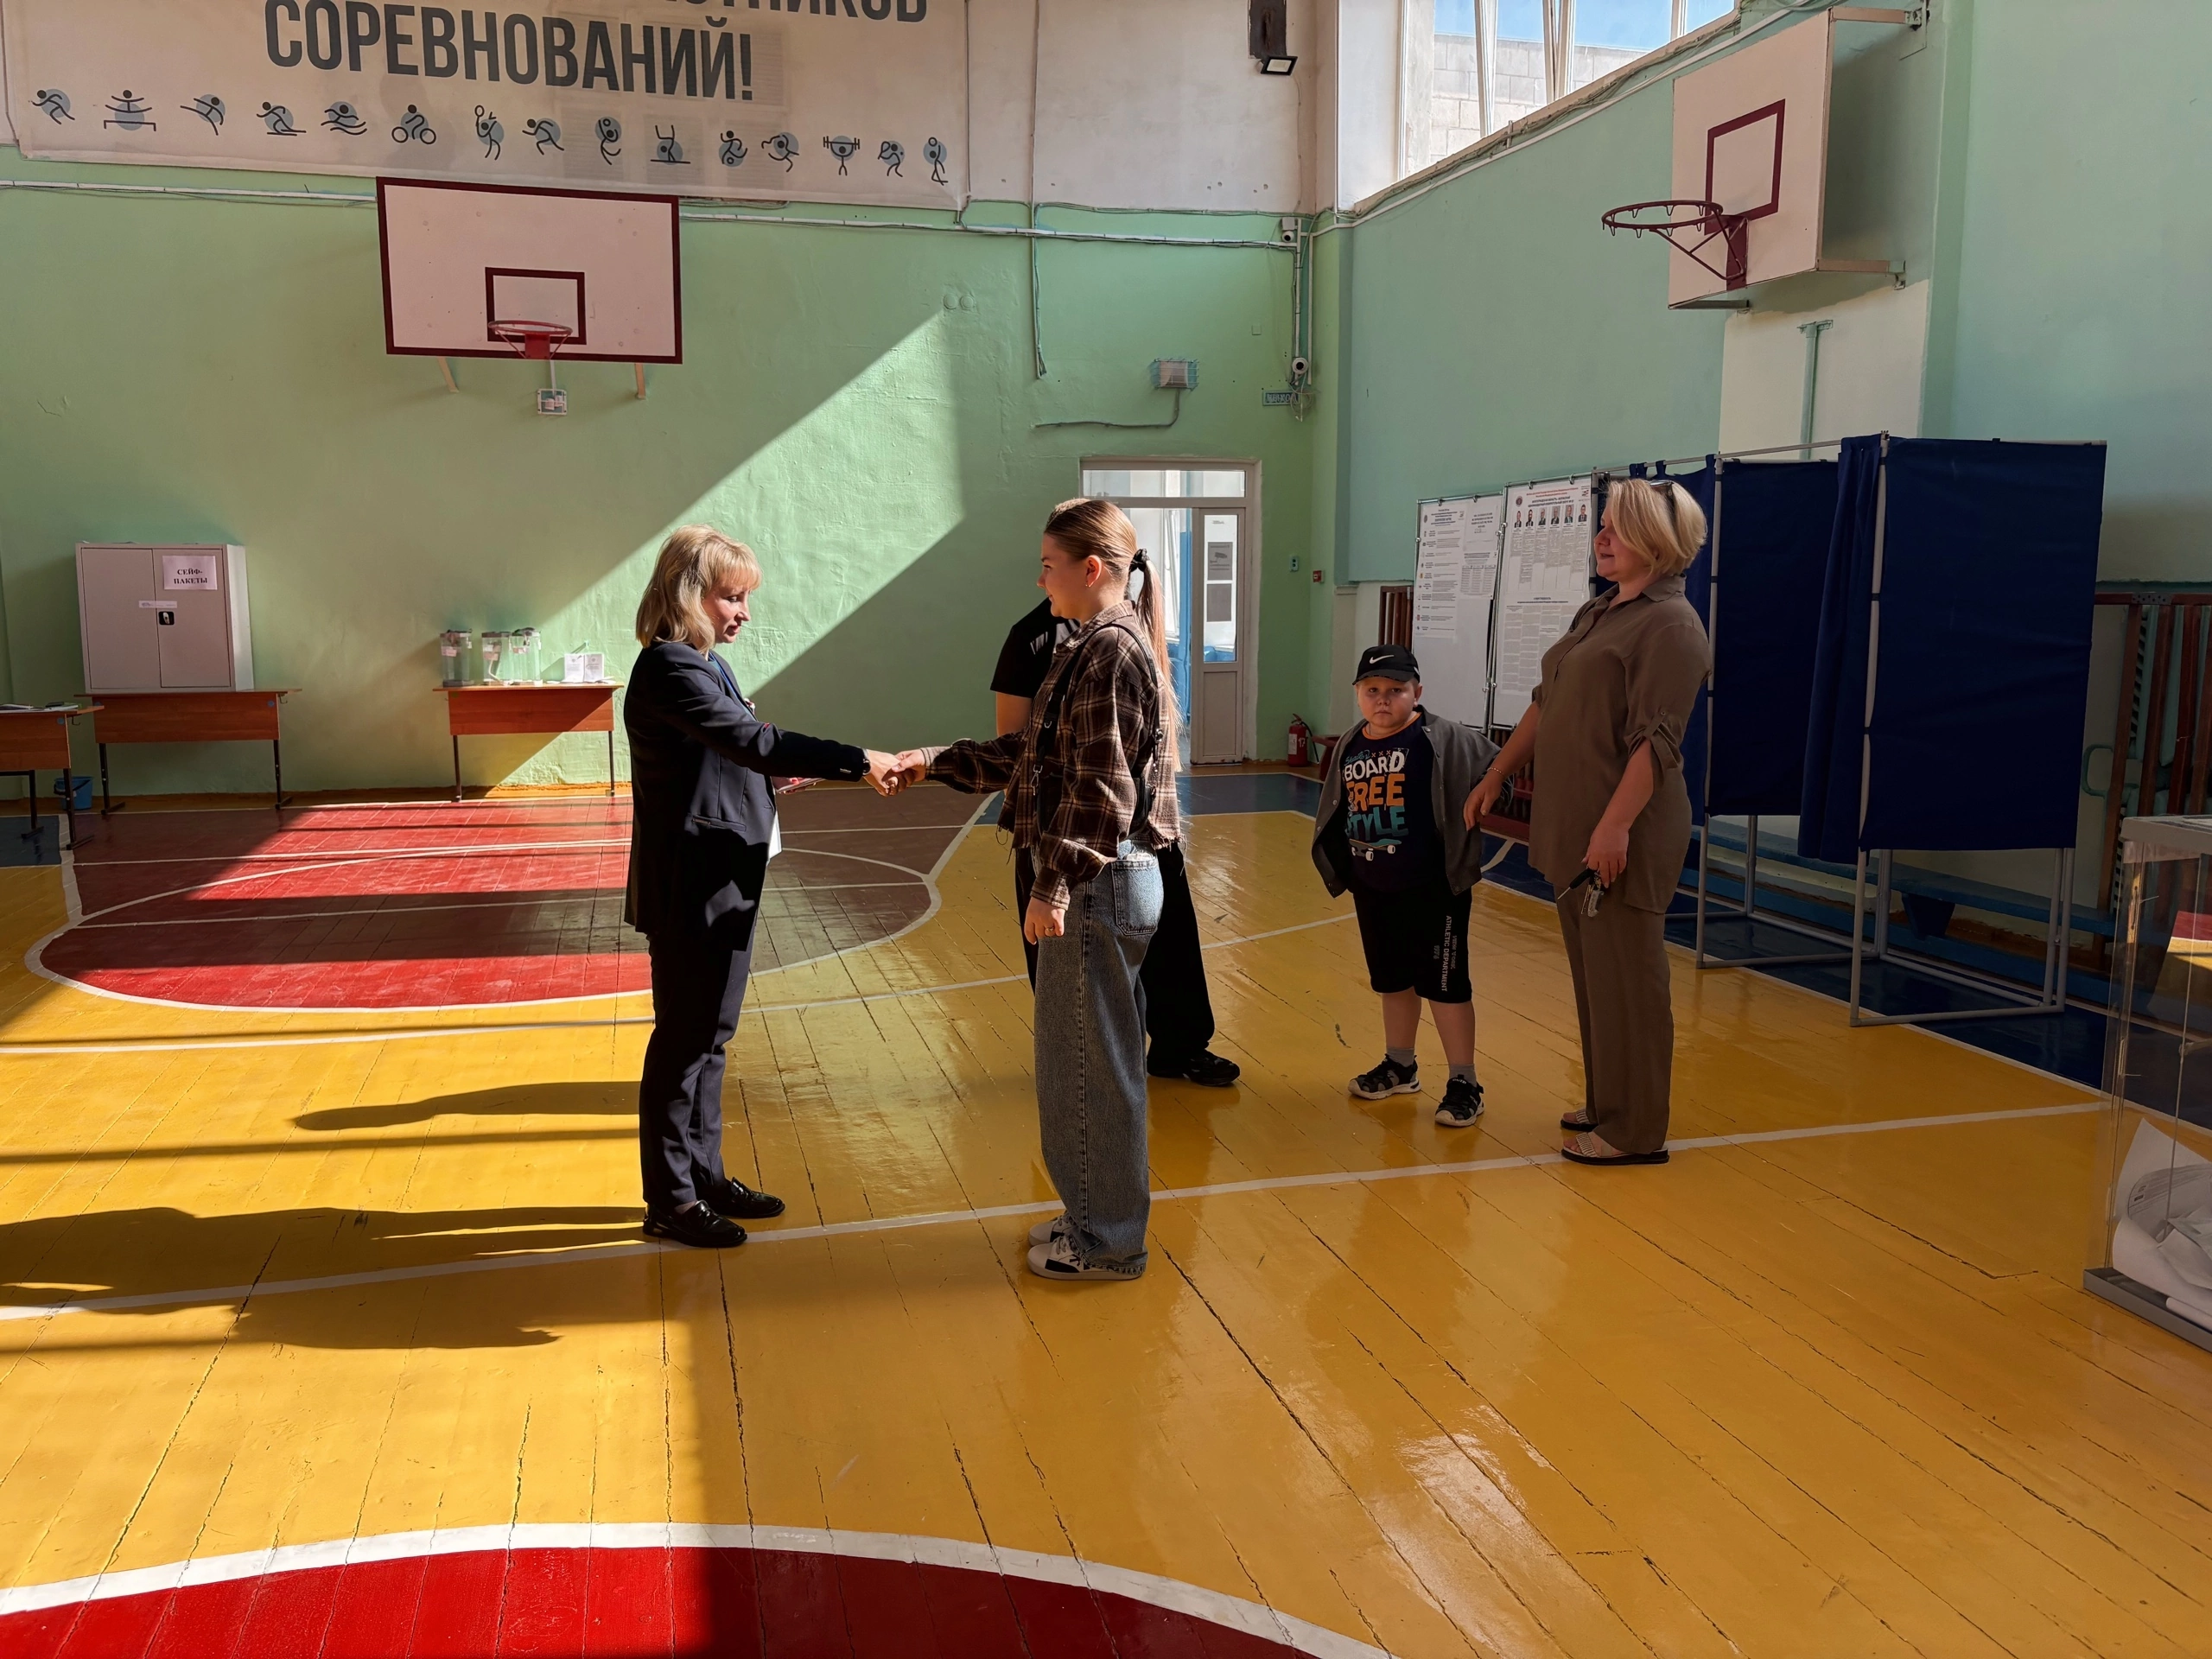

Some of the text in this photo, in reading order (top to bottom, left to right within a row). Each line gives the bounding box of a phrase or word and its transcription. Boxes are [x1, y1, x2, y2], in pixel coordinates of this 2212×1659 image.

[264, 0, 753, 101] СОРЕВНОВАНИЙ!
[1344, 751, 1405, 782] BOARD
[1346, 773, 1406, 812] FREE
[1441, 915, 1452, 992] ATHLETIC DEPARTMENT
